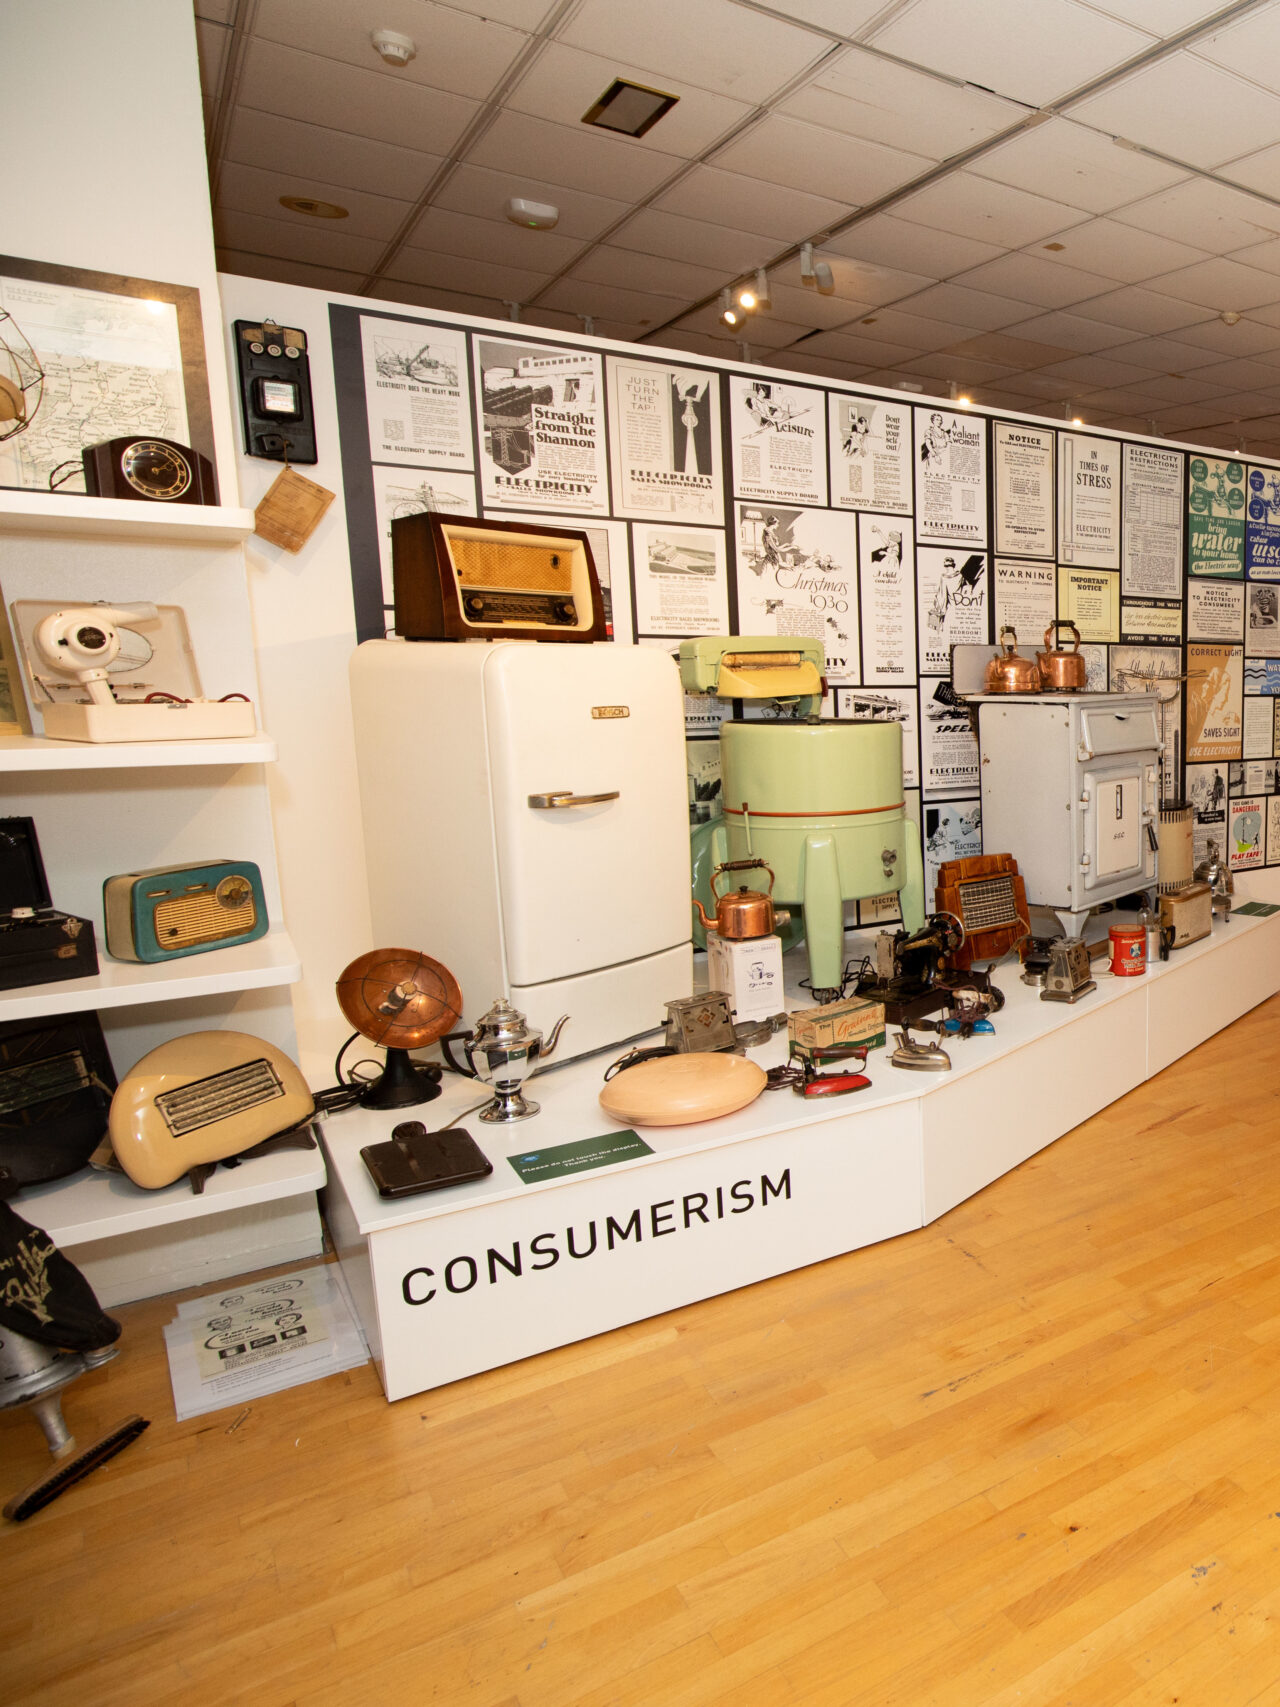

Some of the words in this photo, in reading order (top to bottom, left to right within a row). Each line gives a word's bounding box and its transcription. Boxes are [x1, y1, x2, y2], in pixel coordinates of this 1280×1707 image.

[377, 380, 406, 390] ELECTRICITY
[628, 376, 656, 386] JUST
[626, 384, 659, 395] TURN
[632, 393, 654, 403] THE
[534, 407, 595, 425] Straight
[535, 420, 570, 434] from
[572, 426, 596, 437] the
[952, 419, 957, 428] A
[774, 421, 814, 438] Leisure
[952, 425, 980, 439] valiant
[536, 432, 595, 449] Shannon
[952, 438, 980, 447] woman
[1008, 434, 1041, 445] NOTICE
[1091, 450, 1097, 459] IN
[1130, 449, 1178, 462] ELECTRICITY
[1080, 461, 1098, 472] TIMES
[1100, 465, 1109, 473] OF
[1130, 457, 1178, 468] RESTRICTIONS
[554, 471, 598, 479] ELECTRICITY
[630, 469, 712, 484] ELECTRICITY
[494, 475, 592, 494] ELECTRICITY
[1076, 473, 1112, 489] STRESS
[924, 520, 979, 531] ELECTRICITY
[1076, 524, 1111, 534] ELECTRICITY
[1208, 523, 1227, 535] bring
[1192, 531, 1242, 552] water
[1193, 548, 1200, 556] to
[1202, 549, 1219, 558] your
[1221, 550, 1239, 559] home
[998, 569, 1053, 580] WARNING
[776, 567, 848, 596] Christmas
[1070, 576, 1108, 585] IMPORTANT
[953, 590, 984, 606] Don't
[1191, 648, 1222, 656] CORRECT
[1224, 648, 1243, 657] LIGHT
[1204, 728, 1222, 738] SAVES
[1223, 727, 1240, 737] SIGHT
[1189, 746, 1201, 756] USE
[1202, 746, 1241, 756] ELECTRICITY
[930, 766, 978, 774] ELECTRICIT
[1232, 805, 1260, 814] DANGEROUS
[1231, 852, 1244, 860] PLAY
[521, 1164, 549, 1173] Please
[576, 1153, 598, 1161] touch
[563, 1159, 588, 1167] Thank
[401, 1168, 793, 1307] CONSUMERISM
